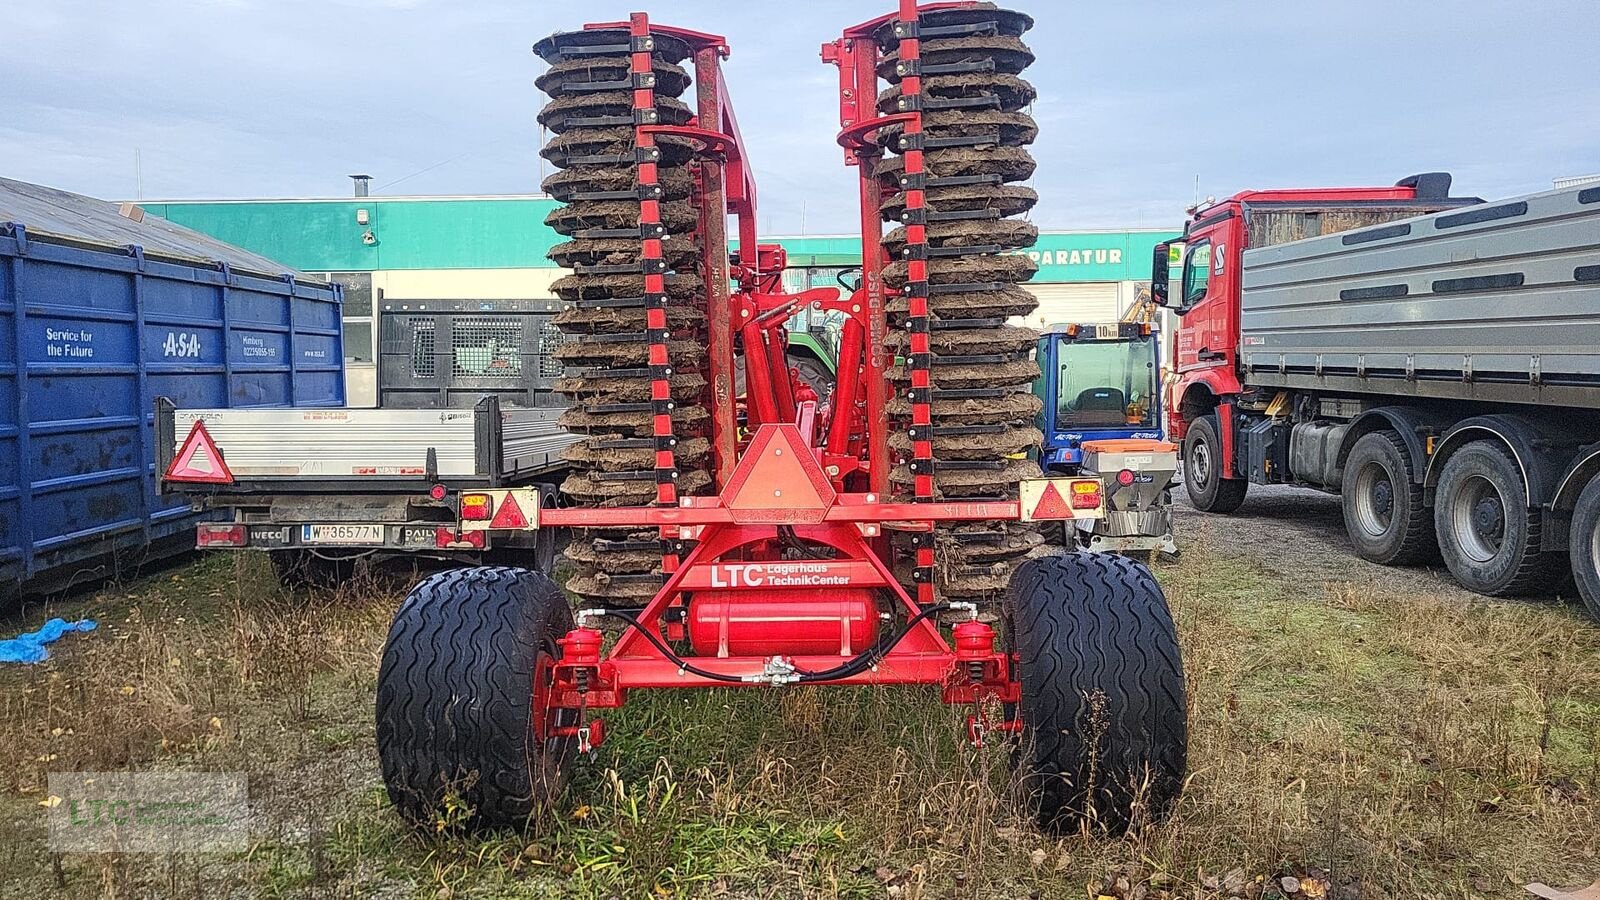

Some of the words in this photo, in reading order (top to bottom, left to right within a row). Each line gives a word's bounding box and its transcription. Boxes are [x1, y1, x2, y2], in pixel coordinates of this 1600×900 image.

[1003, 249, 1122, 265] PARATUR
[867, 270, 883, 368] COMBI-DISC
[46, 327, 79, 341] Service
[81, 329, 92, 342] for
[1098, 325, 1107, 337] 10
[47, 343, 62, 356] the
[65, 343, 93, 357] Future
[250, 531, 282, 540] IVECO
[405, 529, 437, 537] DAILY
[711, 564, 763, 588] LTC
[767, 563, 828, 575] Lagerhaus
[767, 574, 850, 586] TechnikCenter
